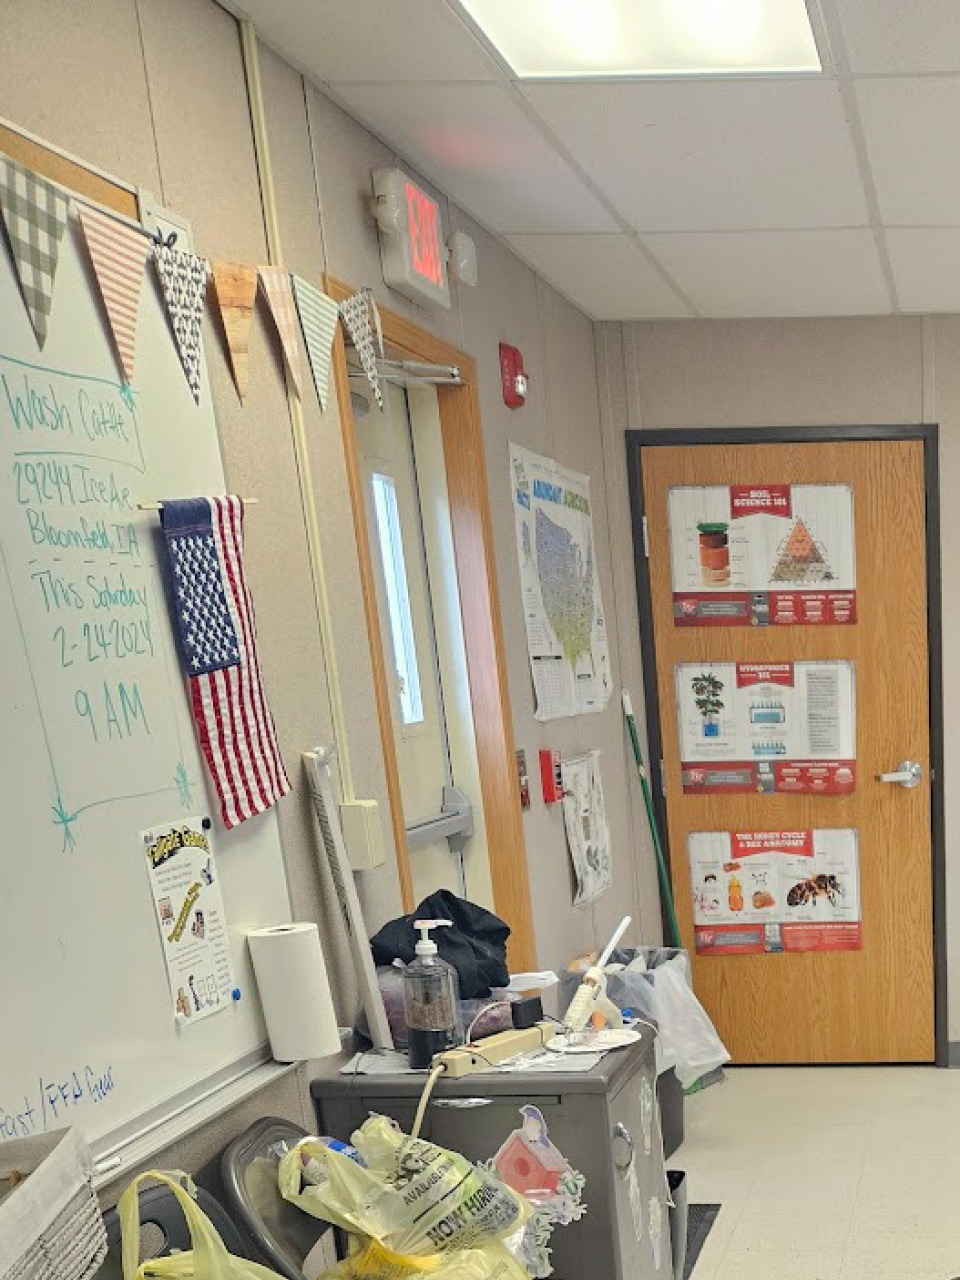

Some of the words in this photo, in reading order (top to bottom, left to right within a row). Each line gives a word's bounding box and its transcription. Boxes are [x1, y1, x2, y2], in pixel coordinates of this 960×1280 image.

[1, 373, 73, 434] Wash
[12, 460, 75, 505] 29244
[31, 569, 84, 612] This
[76, 690, 98, 742] 9
[104, 681, 151, 740] AM
[426, 1206, 468, 1246] NOW
